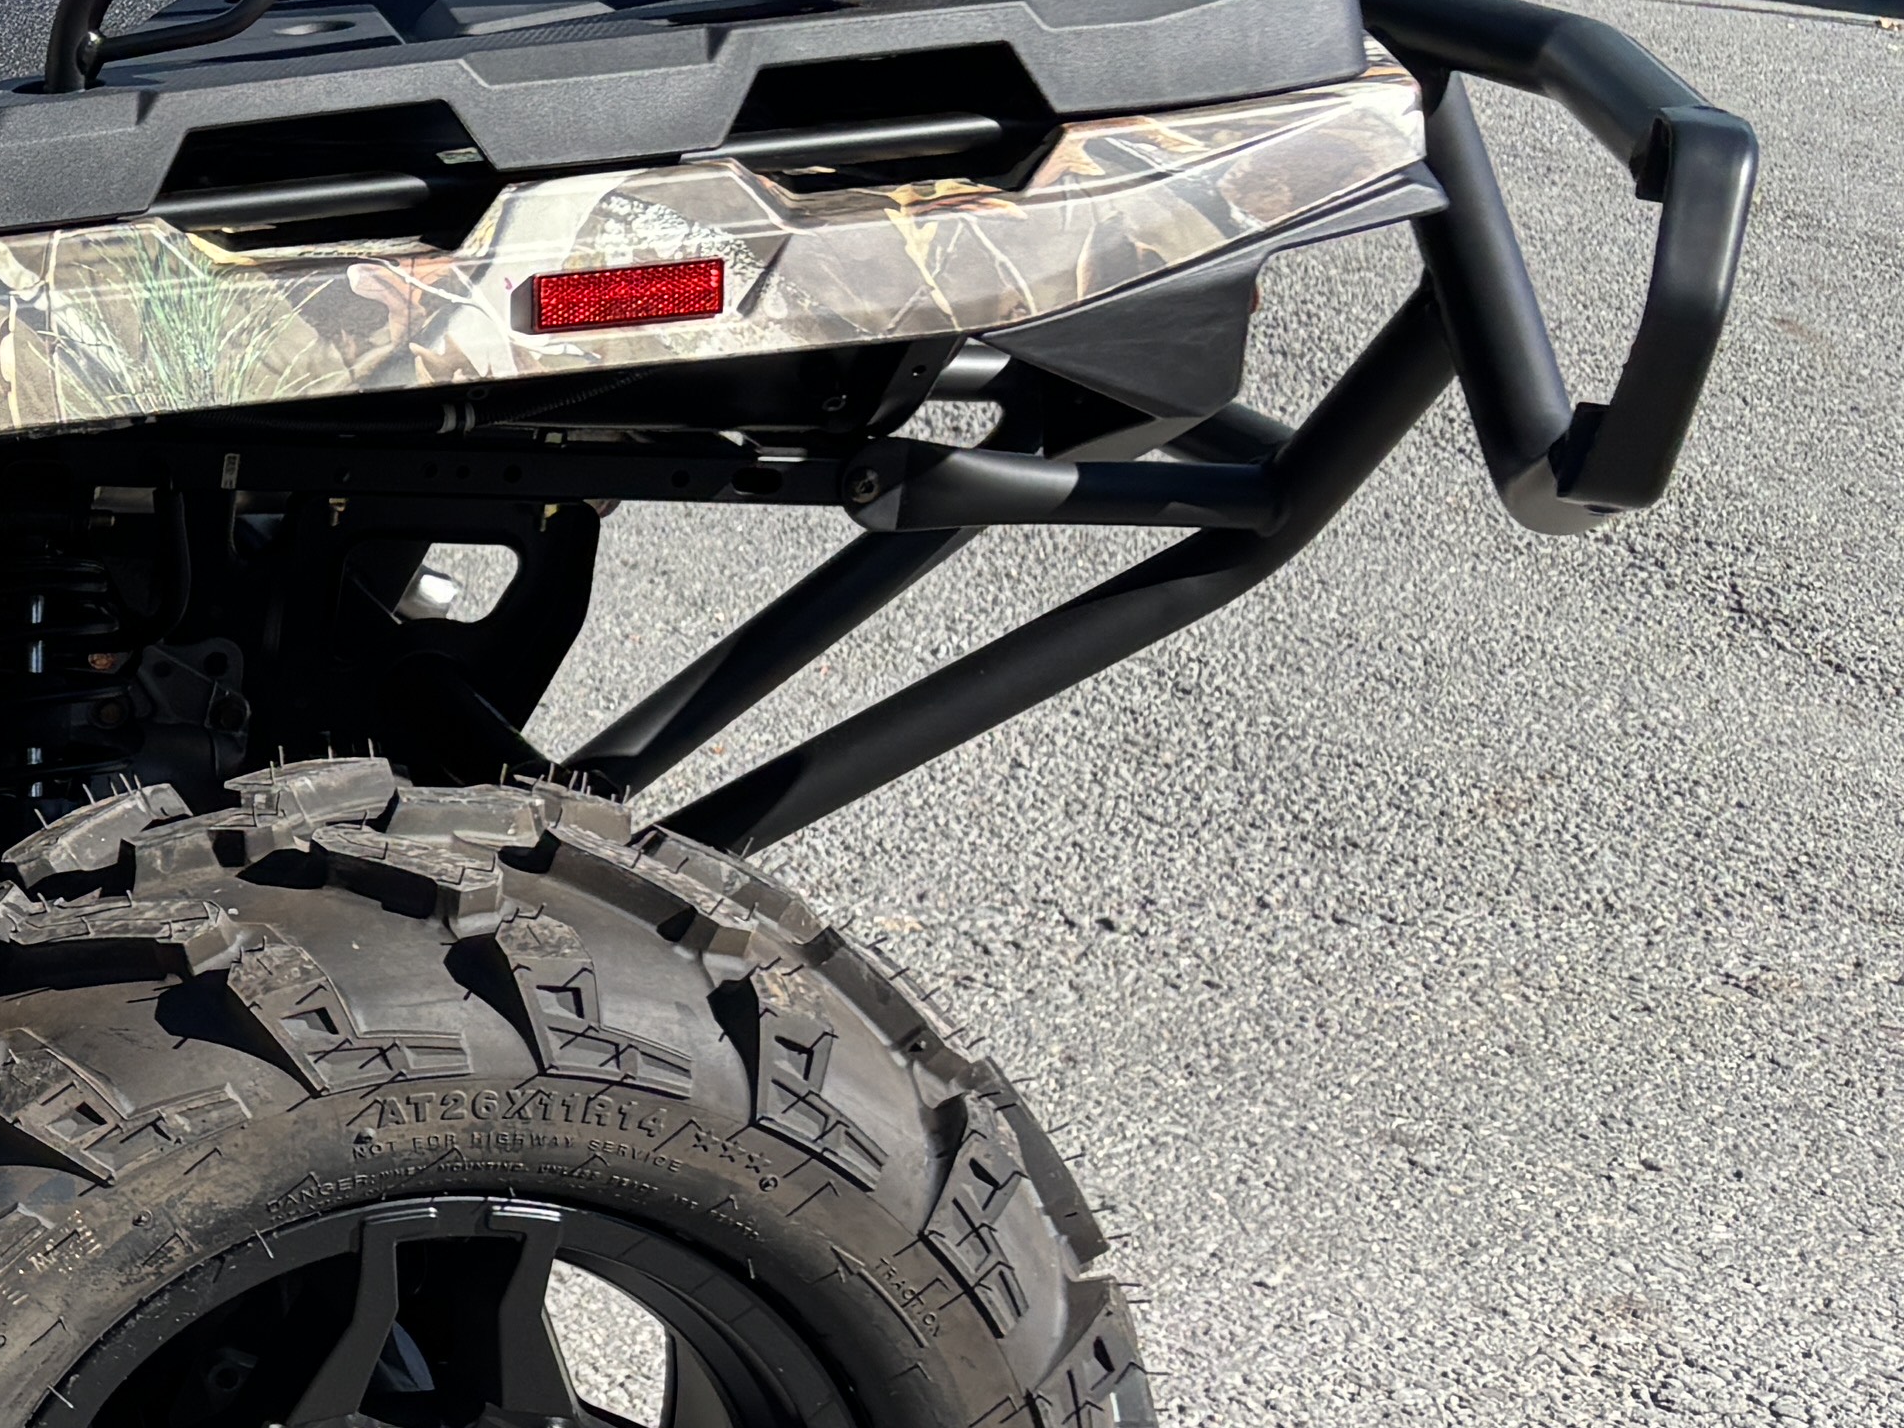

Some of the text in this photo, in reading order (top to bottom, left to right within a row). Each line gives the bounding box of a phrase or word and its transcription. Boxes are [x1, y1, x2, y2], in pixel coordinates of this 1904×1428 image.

[350, 1129, 686, 1175] NOT FOR HIGHWAY SERVICE
[872, 1254, 948, 1340] TRACTION
